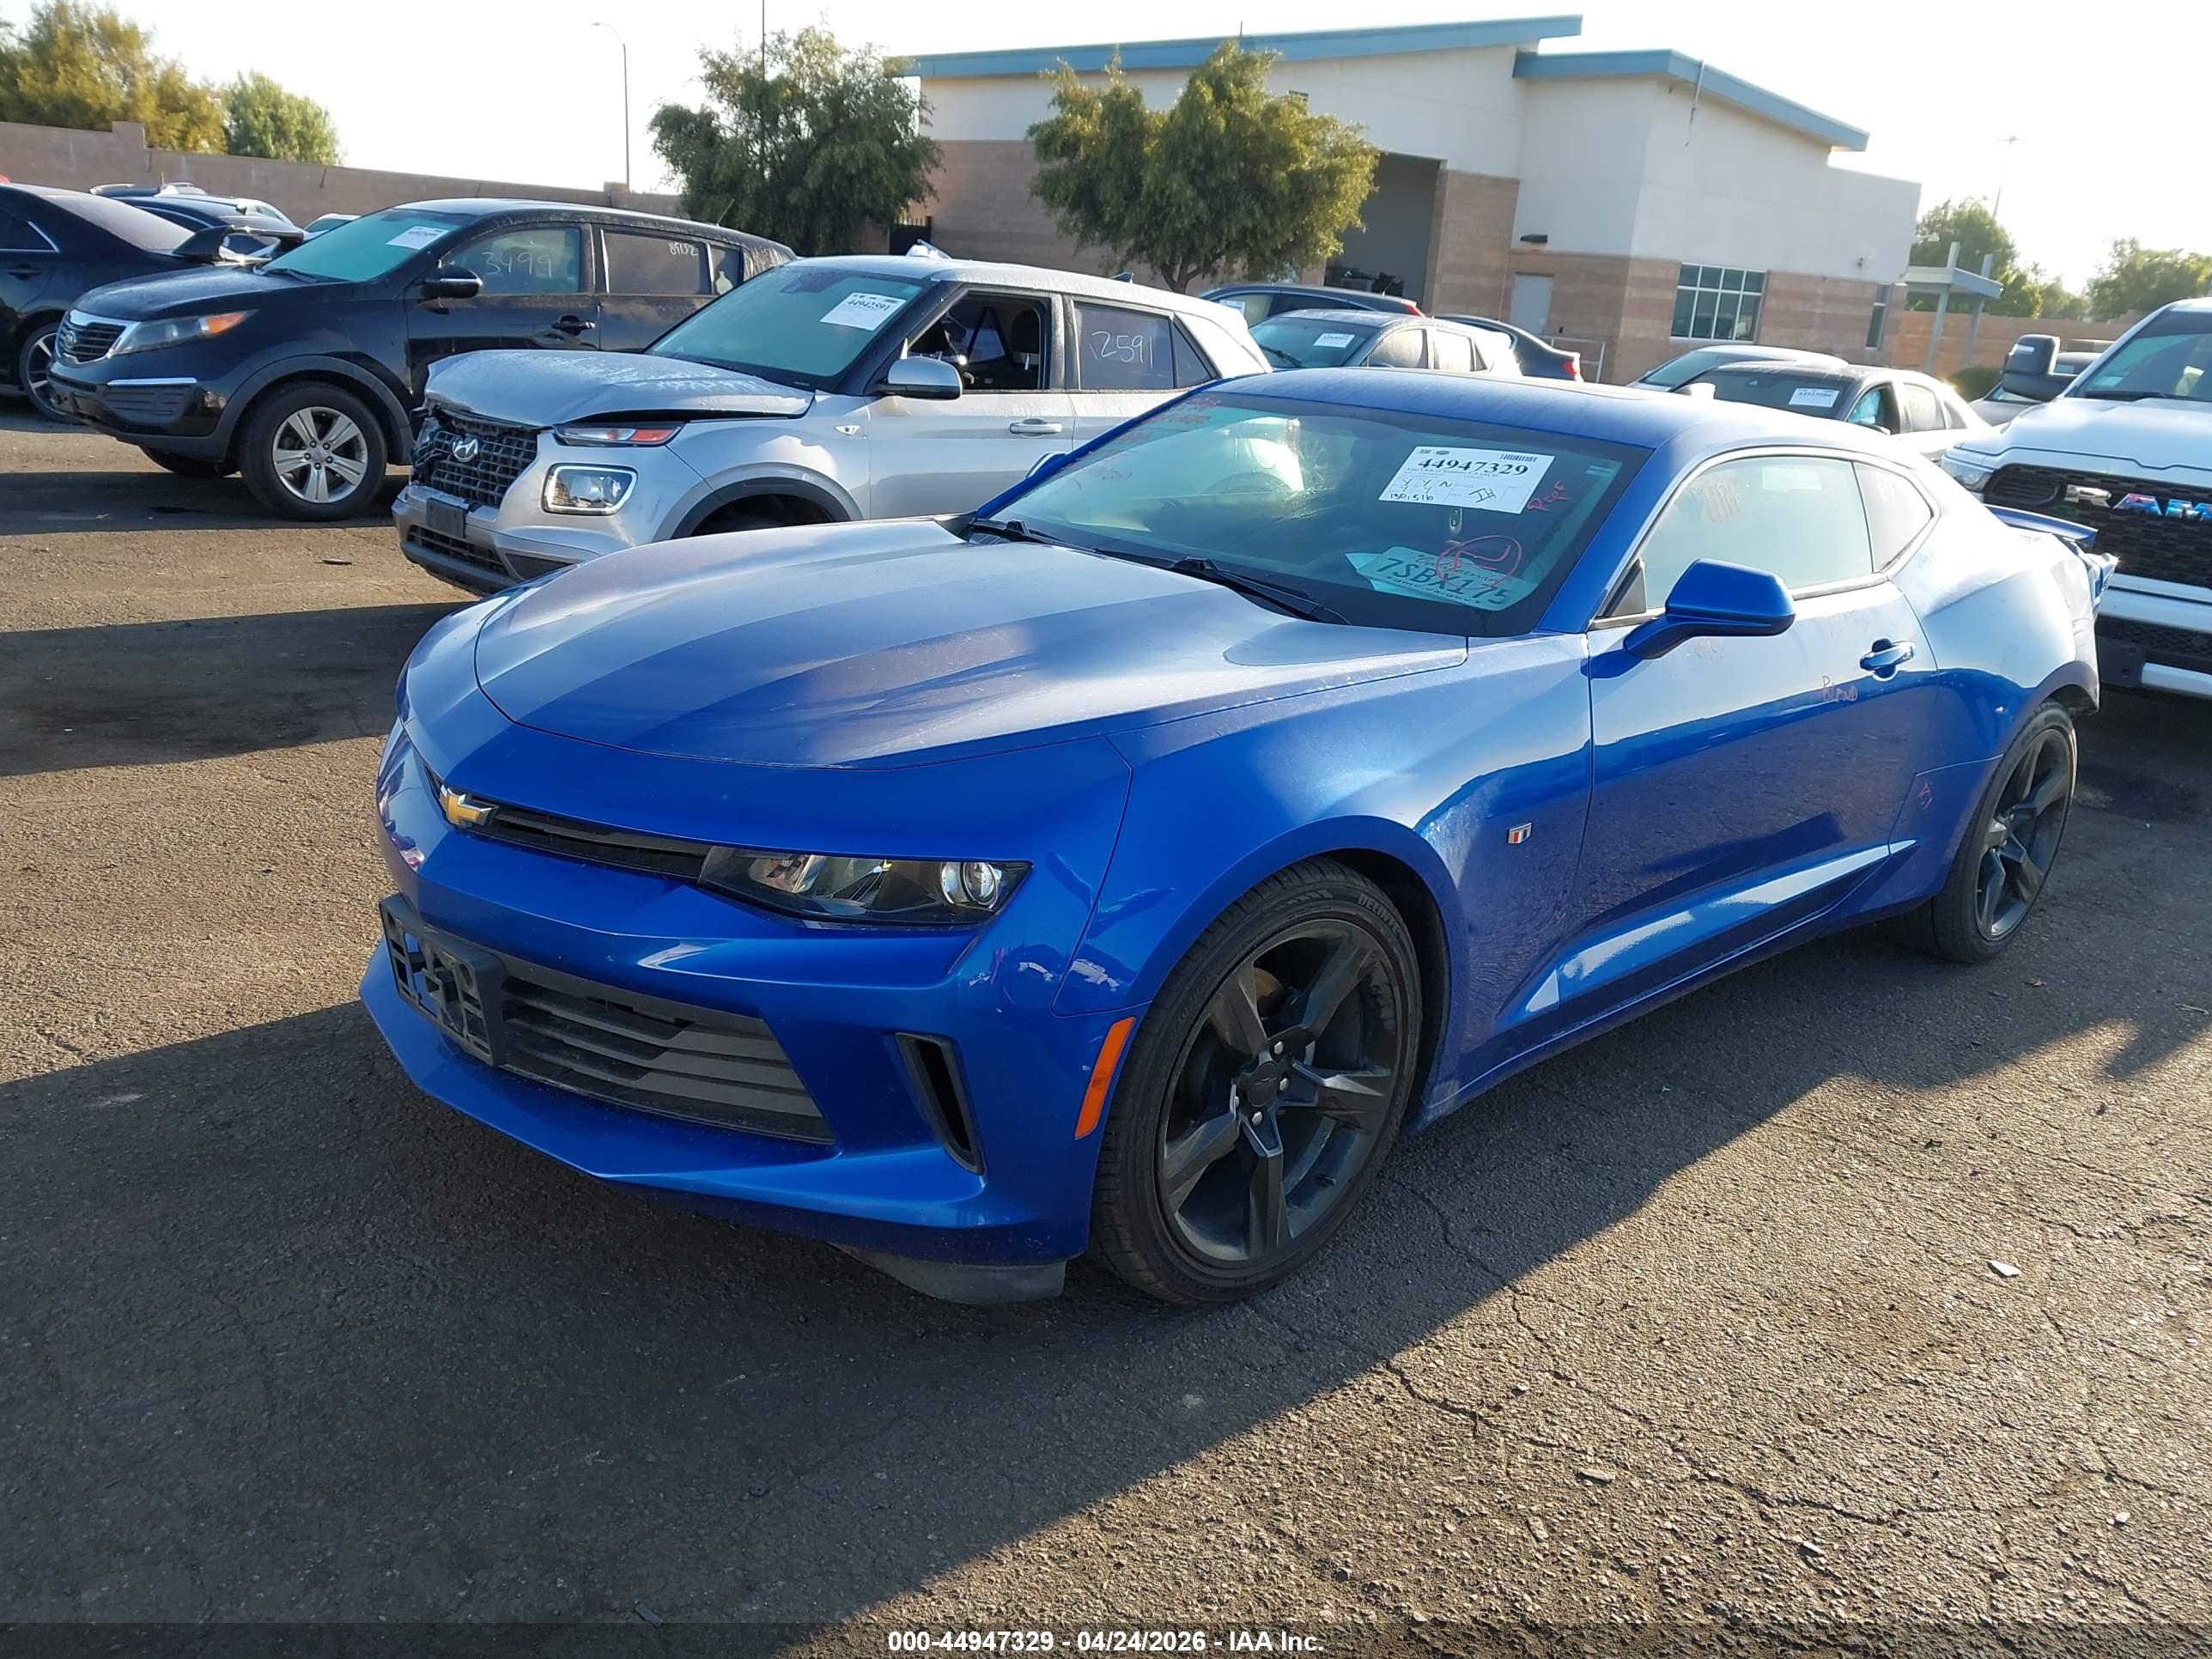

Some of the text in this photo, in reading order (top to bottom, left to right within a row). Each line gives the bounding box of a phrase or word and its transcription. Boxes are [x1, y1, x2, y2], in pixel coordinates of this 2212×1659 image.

[482, 252, 552, 277] 3499
[1418, 458, 1528, 477] 44947329
[1377, 557, 1514, 605] 7SBX175
